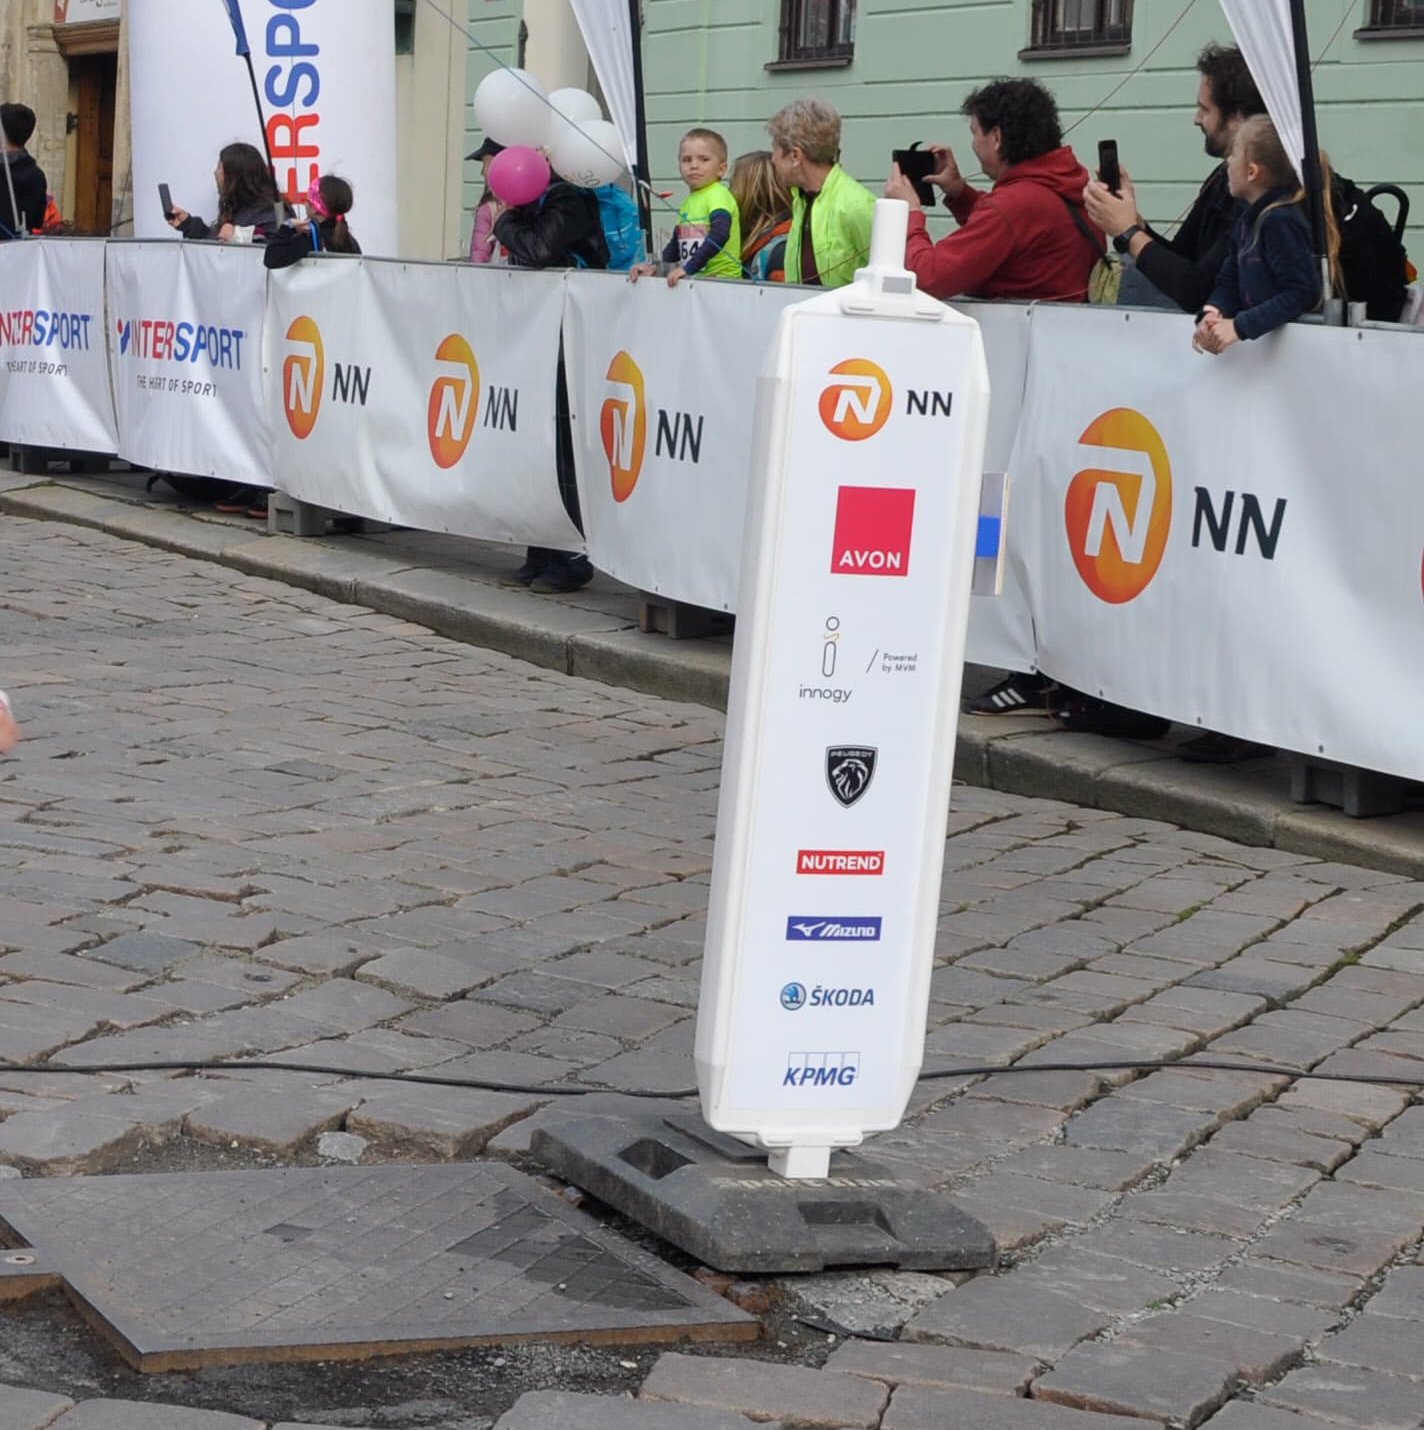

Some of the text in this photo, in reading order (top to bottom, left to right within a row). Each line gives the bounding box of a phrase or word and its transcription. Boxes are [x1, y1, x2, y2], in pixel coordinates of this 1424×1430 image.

[332, 363, 372, 406] NN
[484, 385, 519, 432] NN
[906, 390, 953, 417] NN
[655, 409, 705, 464] NN
[1191, 485, 1288, 561] NN
[839, 550, 902, 569] AVON
[883, 652, 918, 663] Powered
[799, 683, 853, 703] innogy
[800, 854, 882, 871] NUTREND
[809, 985, 875, 1007] ŠKODA
[782, 1065, 857, 1087] KPMG
